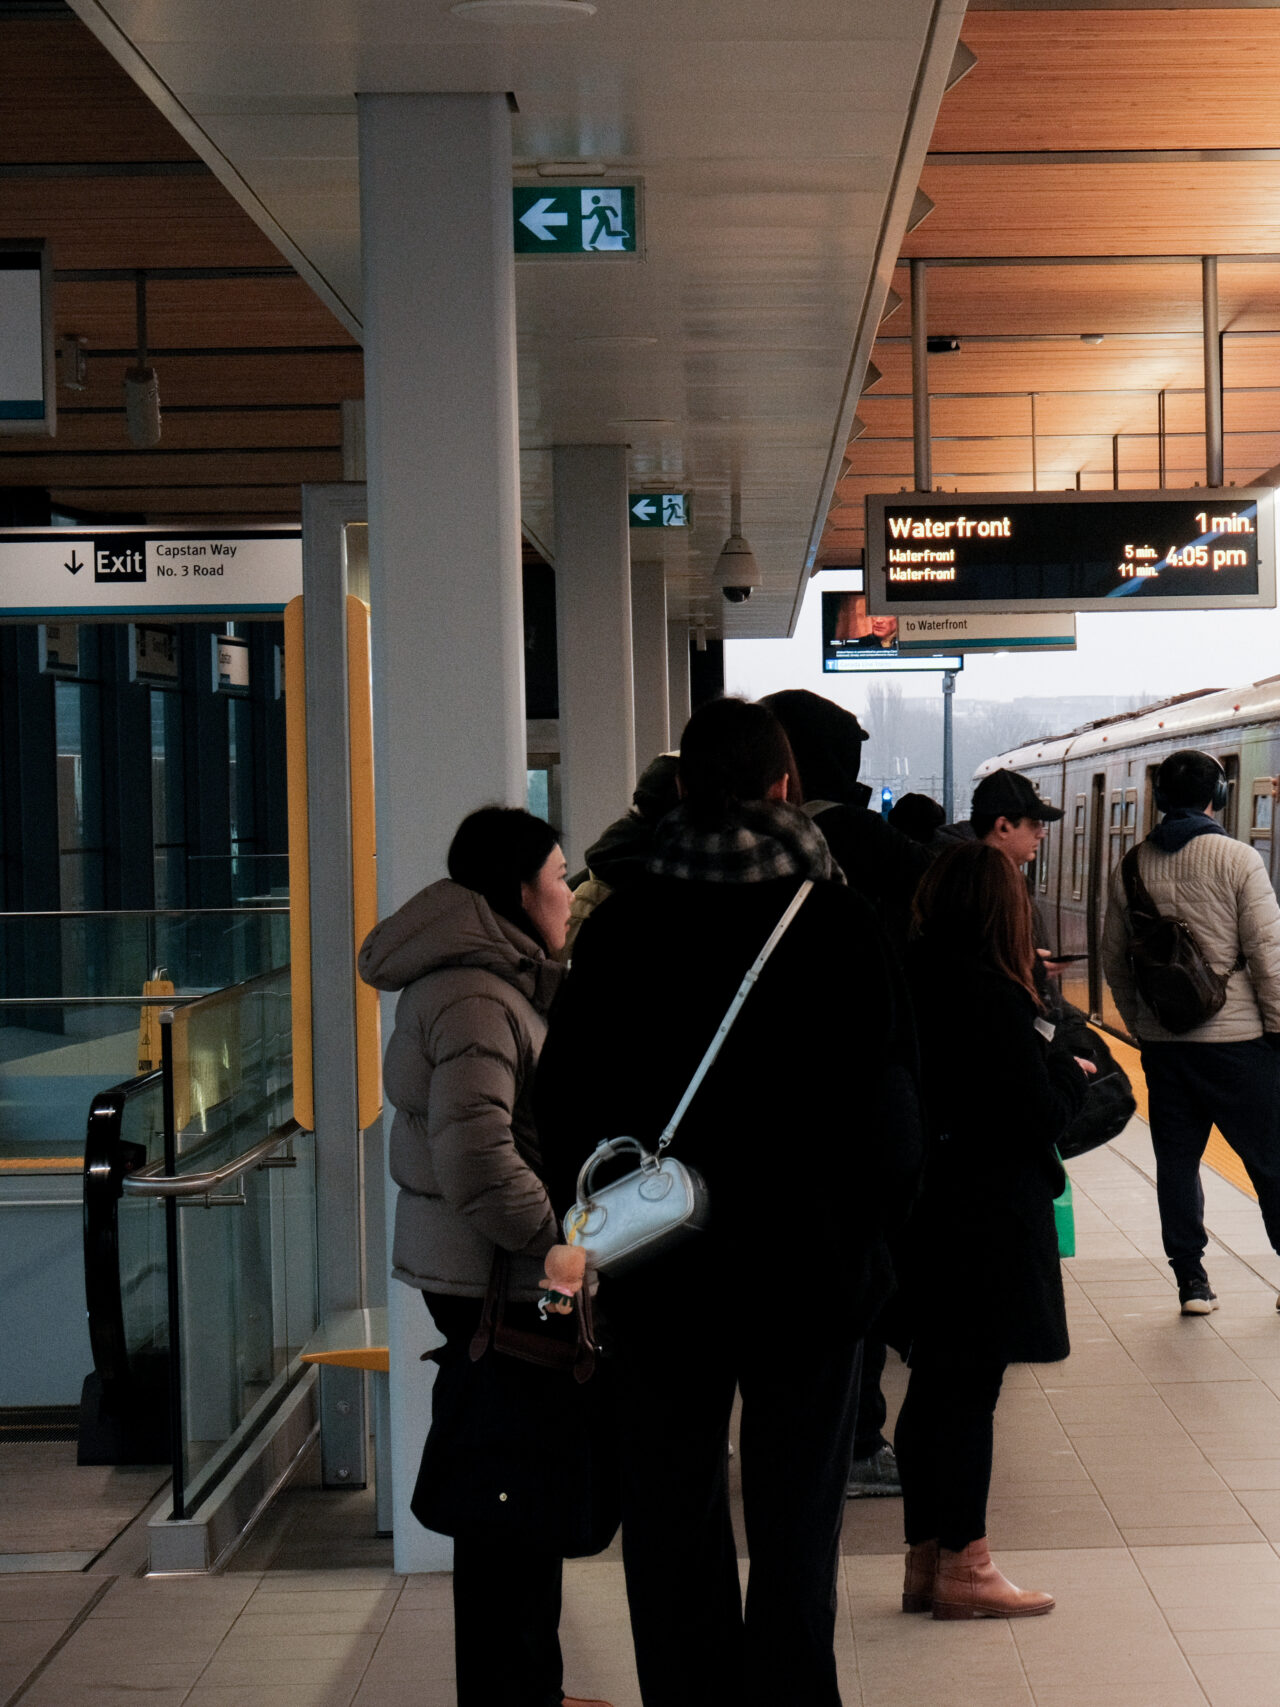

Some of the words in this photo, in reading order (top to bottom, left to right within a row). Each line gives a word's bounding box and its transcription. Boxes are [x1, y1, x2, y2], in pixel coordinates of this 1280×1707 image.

[889, 517, 1011, 538] Waterfront
[1196, 512, 1207, 533] 1
[1211, 512, 1255, 533] min.
[156, 544, 206, 558] Capstan
[210, 544, 237, 558] Way
[889, 549, 955, 562] Waterfront
[1125, 545, 1134, 558] 5
[1136, 545, 1158, 558] min.
[1166, 546, 1208, 567] 4:05
[1214, 549, 1247, 571] pm
[96, 550, 143, 574] Exit
[157, 565, 177, 576] No.
[181, 565, 189, 576] 3
[193, 564, 224, 576] Road
[889, 567, 955, 581] Waterfront
[1118, 563, 1134, 577] 11
[1136, 563, 1159, 577] min.
[906, 620, 916, 631] to
[918, 619, 968, 631] Waterfront
